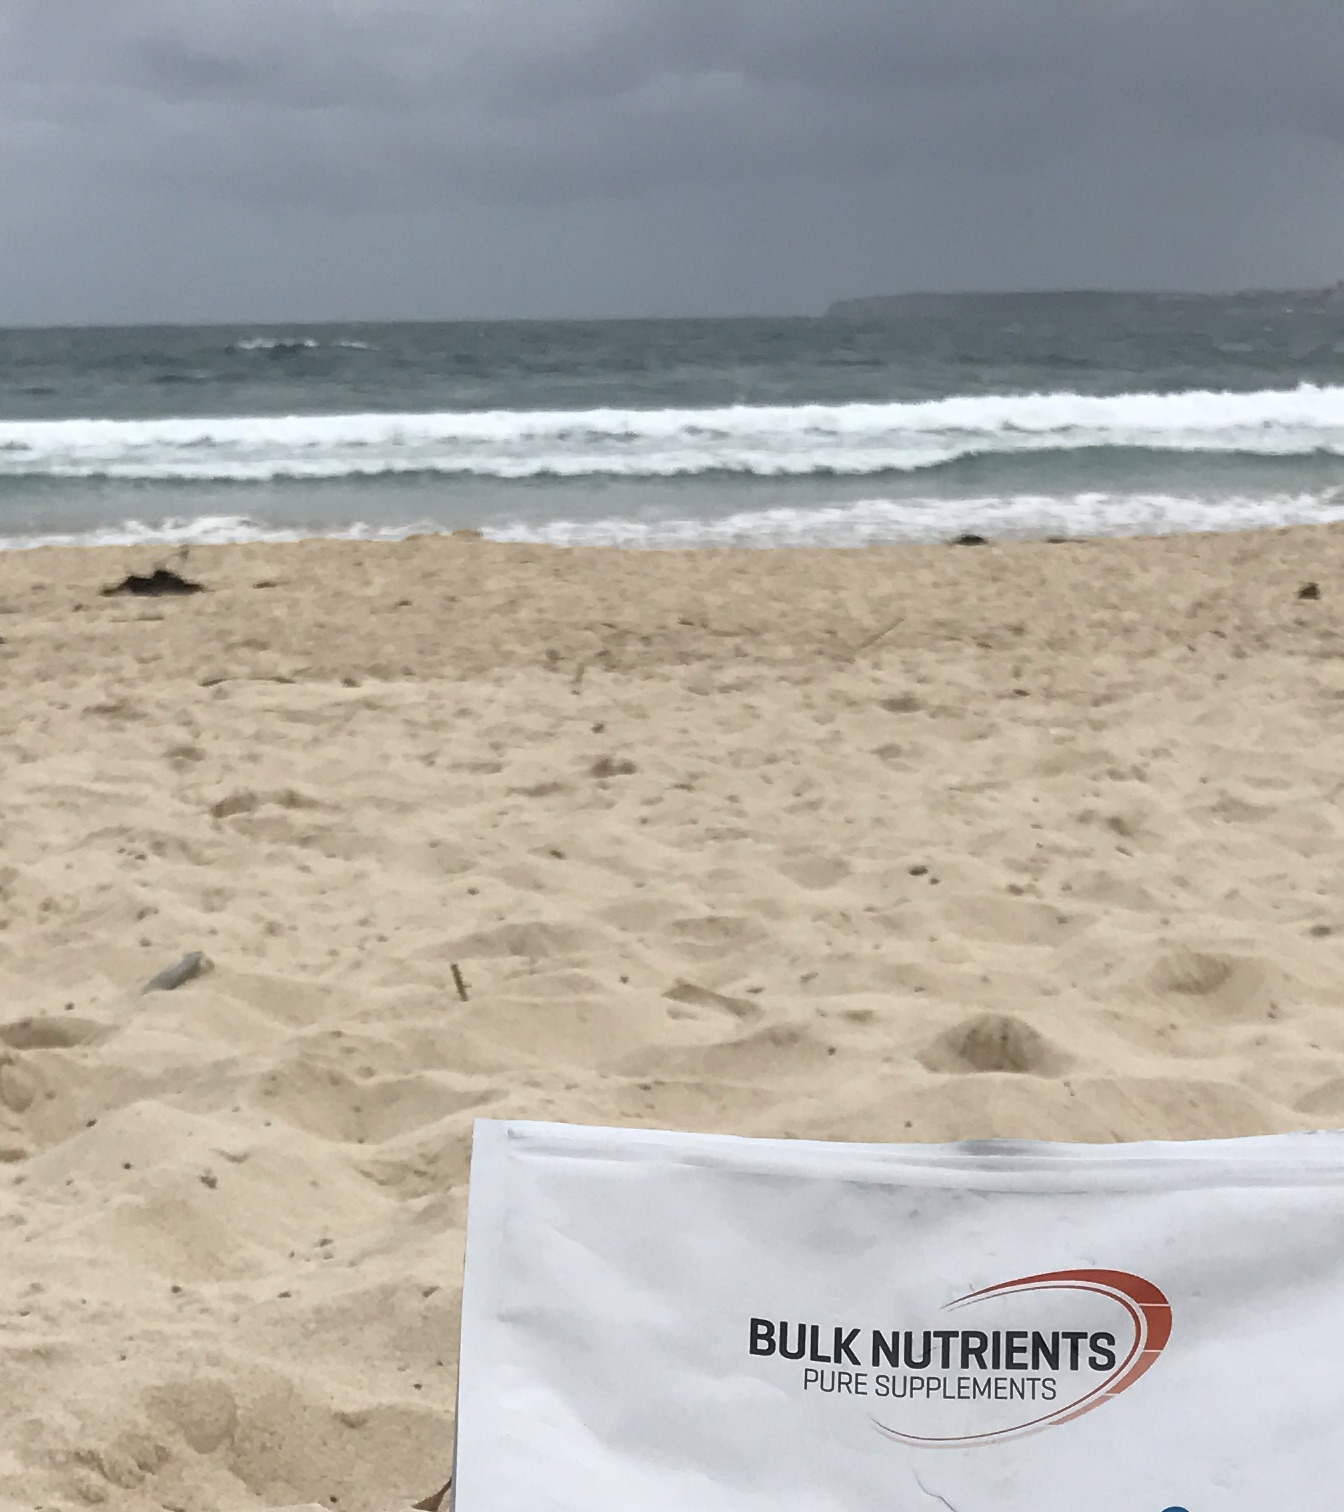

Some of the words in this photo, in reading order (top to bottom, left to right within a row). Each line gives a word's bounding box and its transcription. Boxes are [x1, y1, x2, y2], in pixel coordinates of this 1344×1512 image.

[749, 1317, 862, 1367] BULK
[870, 1329, 1116, 1372] NUTRIENTS
[803, 1368, 868, 1396] PURE
[874, 1373, 1057, 1401] SUPPLEMENTS
